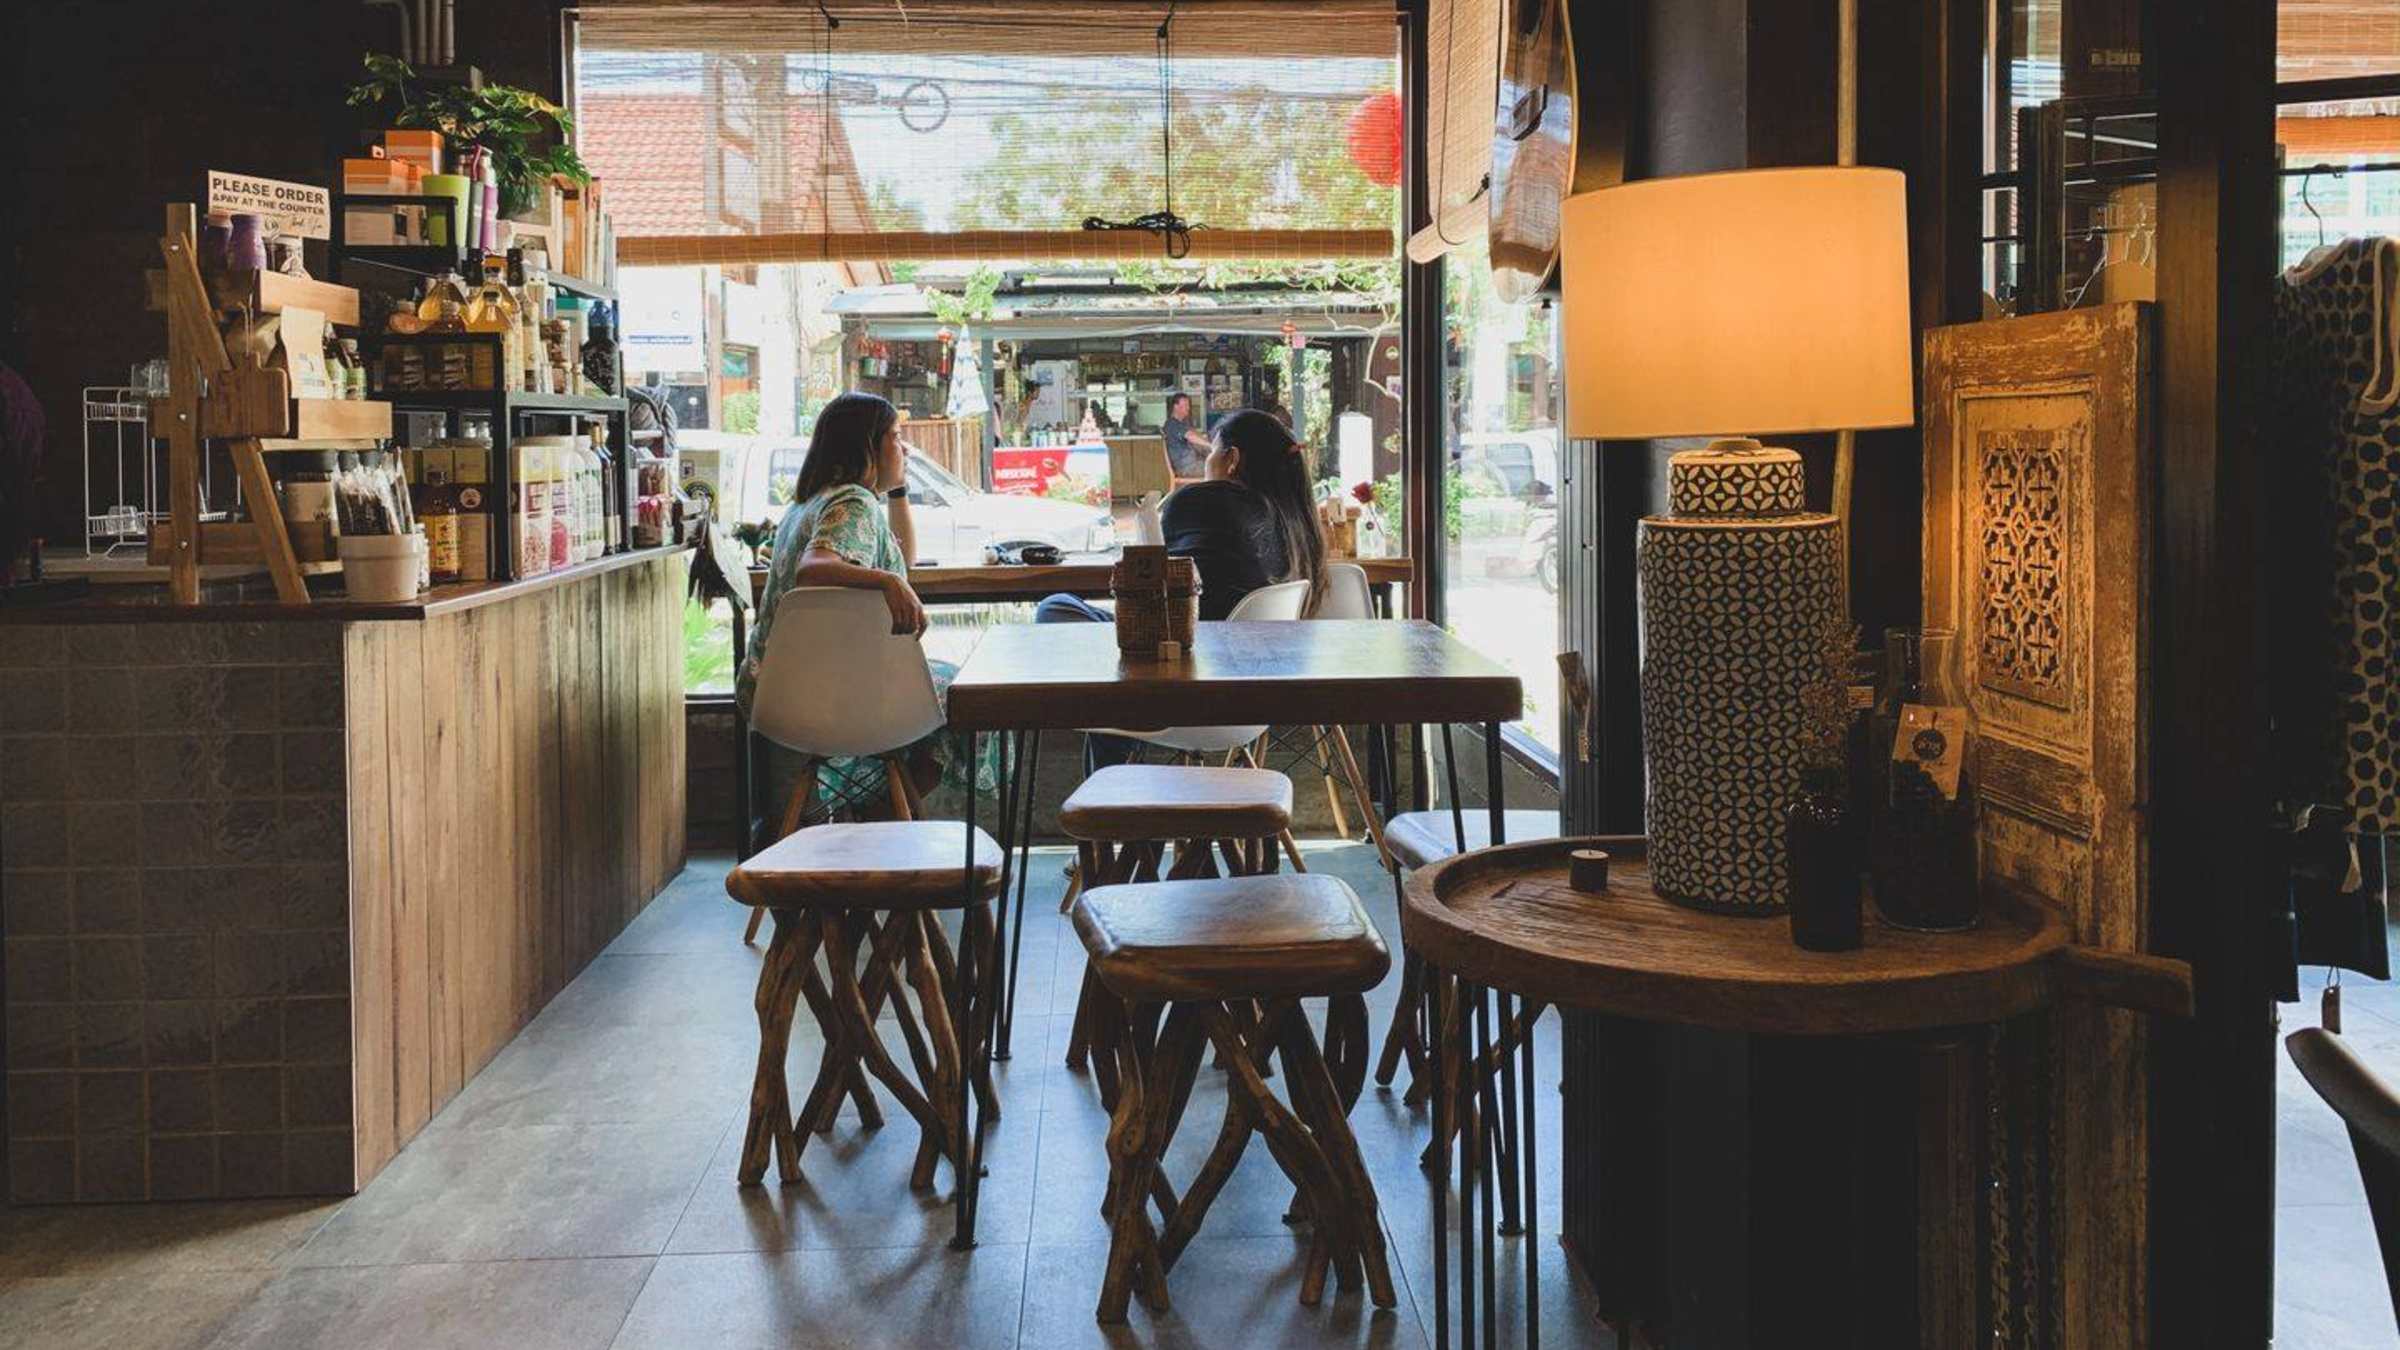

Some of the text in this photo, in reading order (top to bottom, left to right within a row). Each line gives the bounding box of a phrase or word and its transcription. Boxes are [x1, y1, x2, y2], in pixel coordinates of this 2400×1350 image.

[213, 178, 325, 205] PLEASE ORDER
[241, 198, 254, 207] AT
[257, 199, 276, 210] THE
[279, 201, 325, 216] COUNTER
